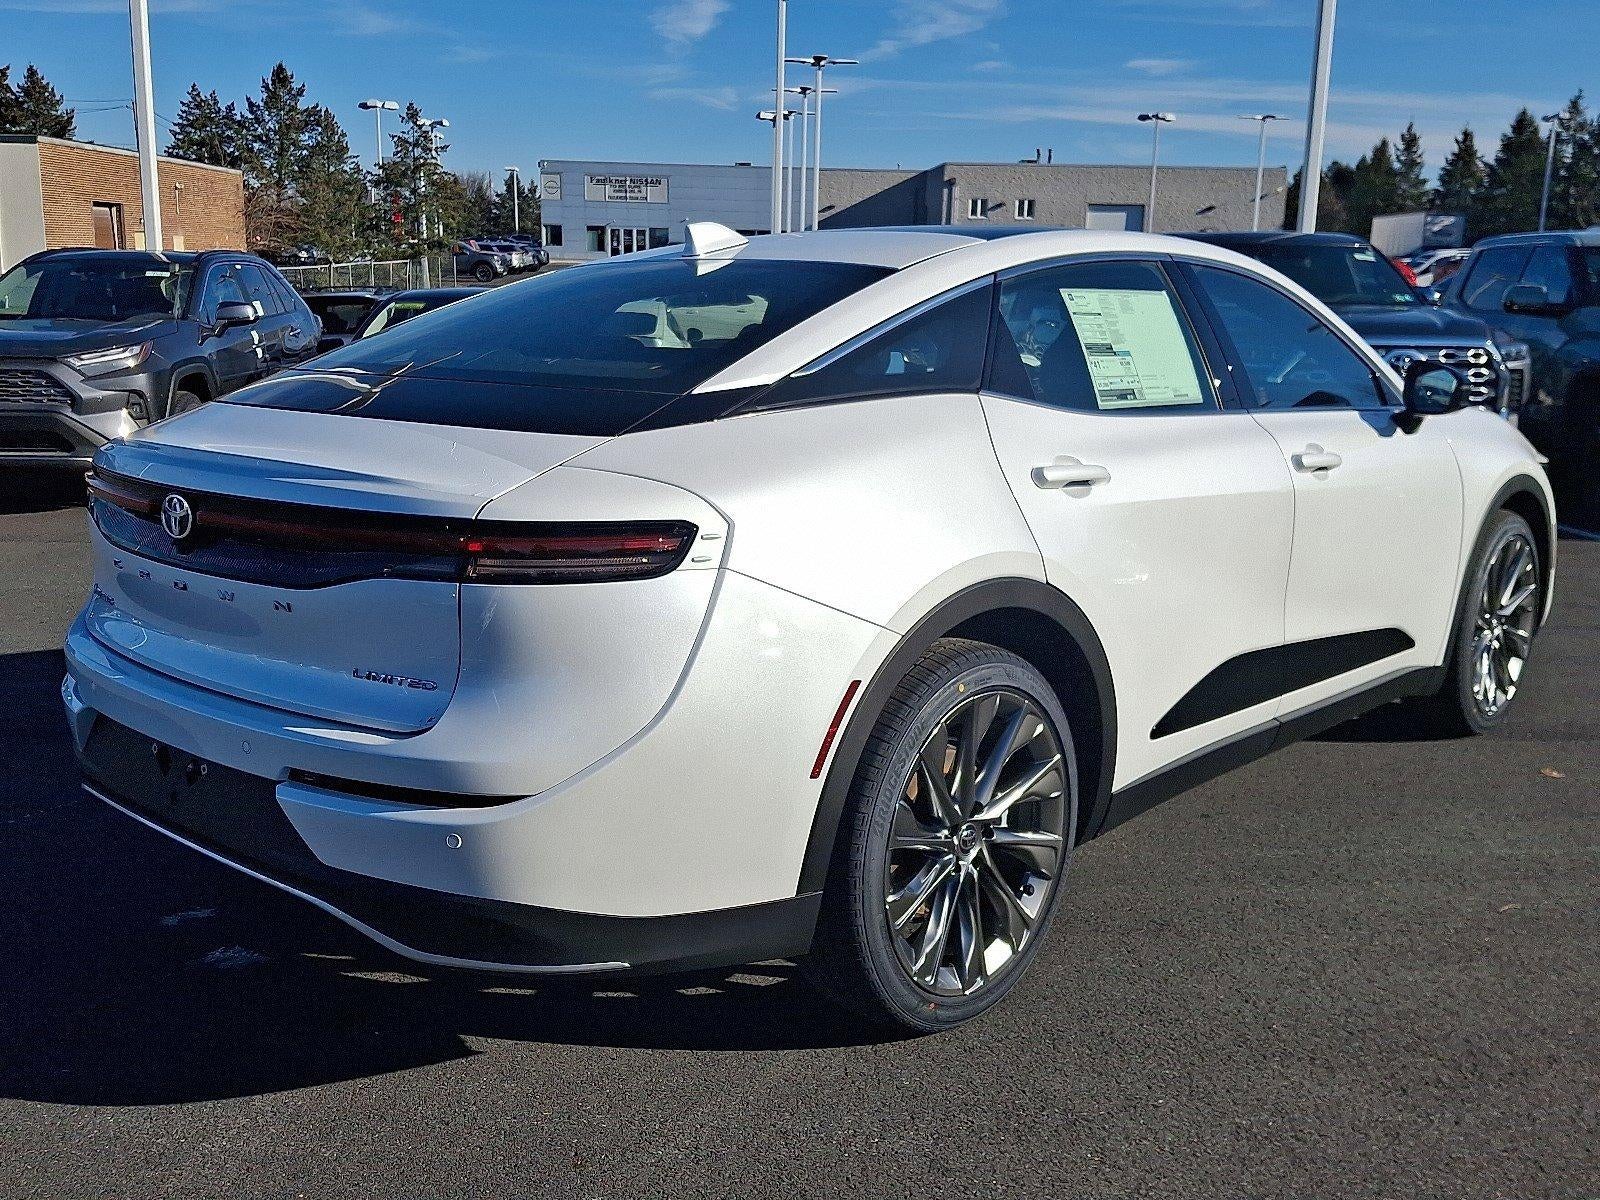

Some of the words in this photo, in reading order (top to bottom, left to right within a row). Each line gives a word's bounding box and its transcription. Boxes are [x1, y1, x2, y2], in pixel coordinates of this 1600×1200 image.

[590, 176, 628, 185] Faulkner
[629, 177, 662, 186] NISSAN
[112, 557, 294, 613] CROWN
[352, 667, 438, 692] LIMITED
